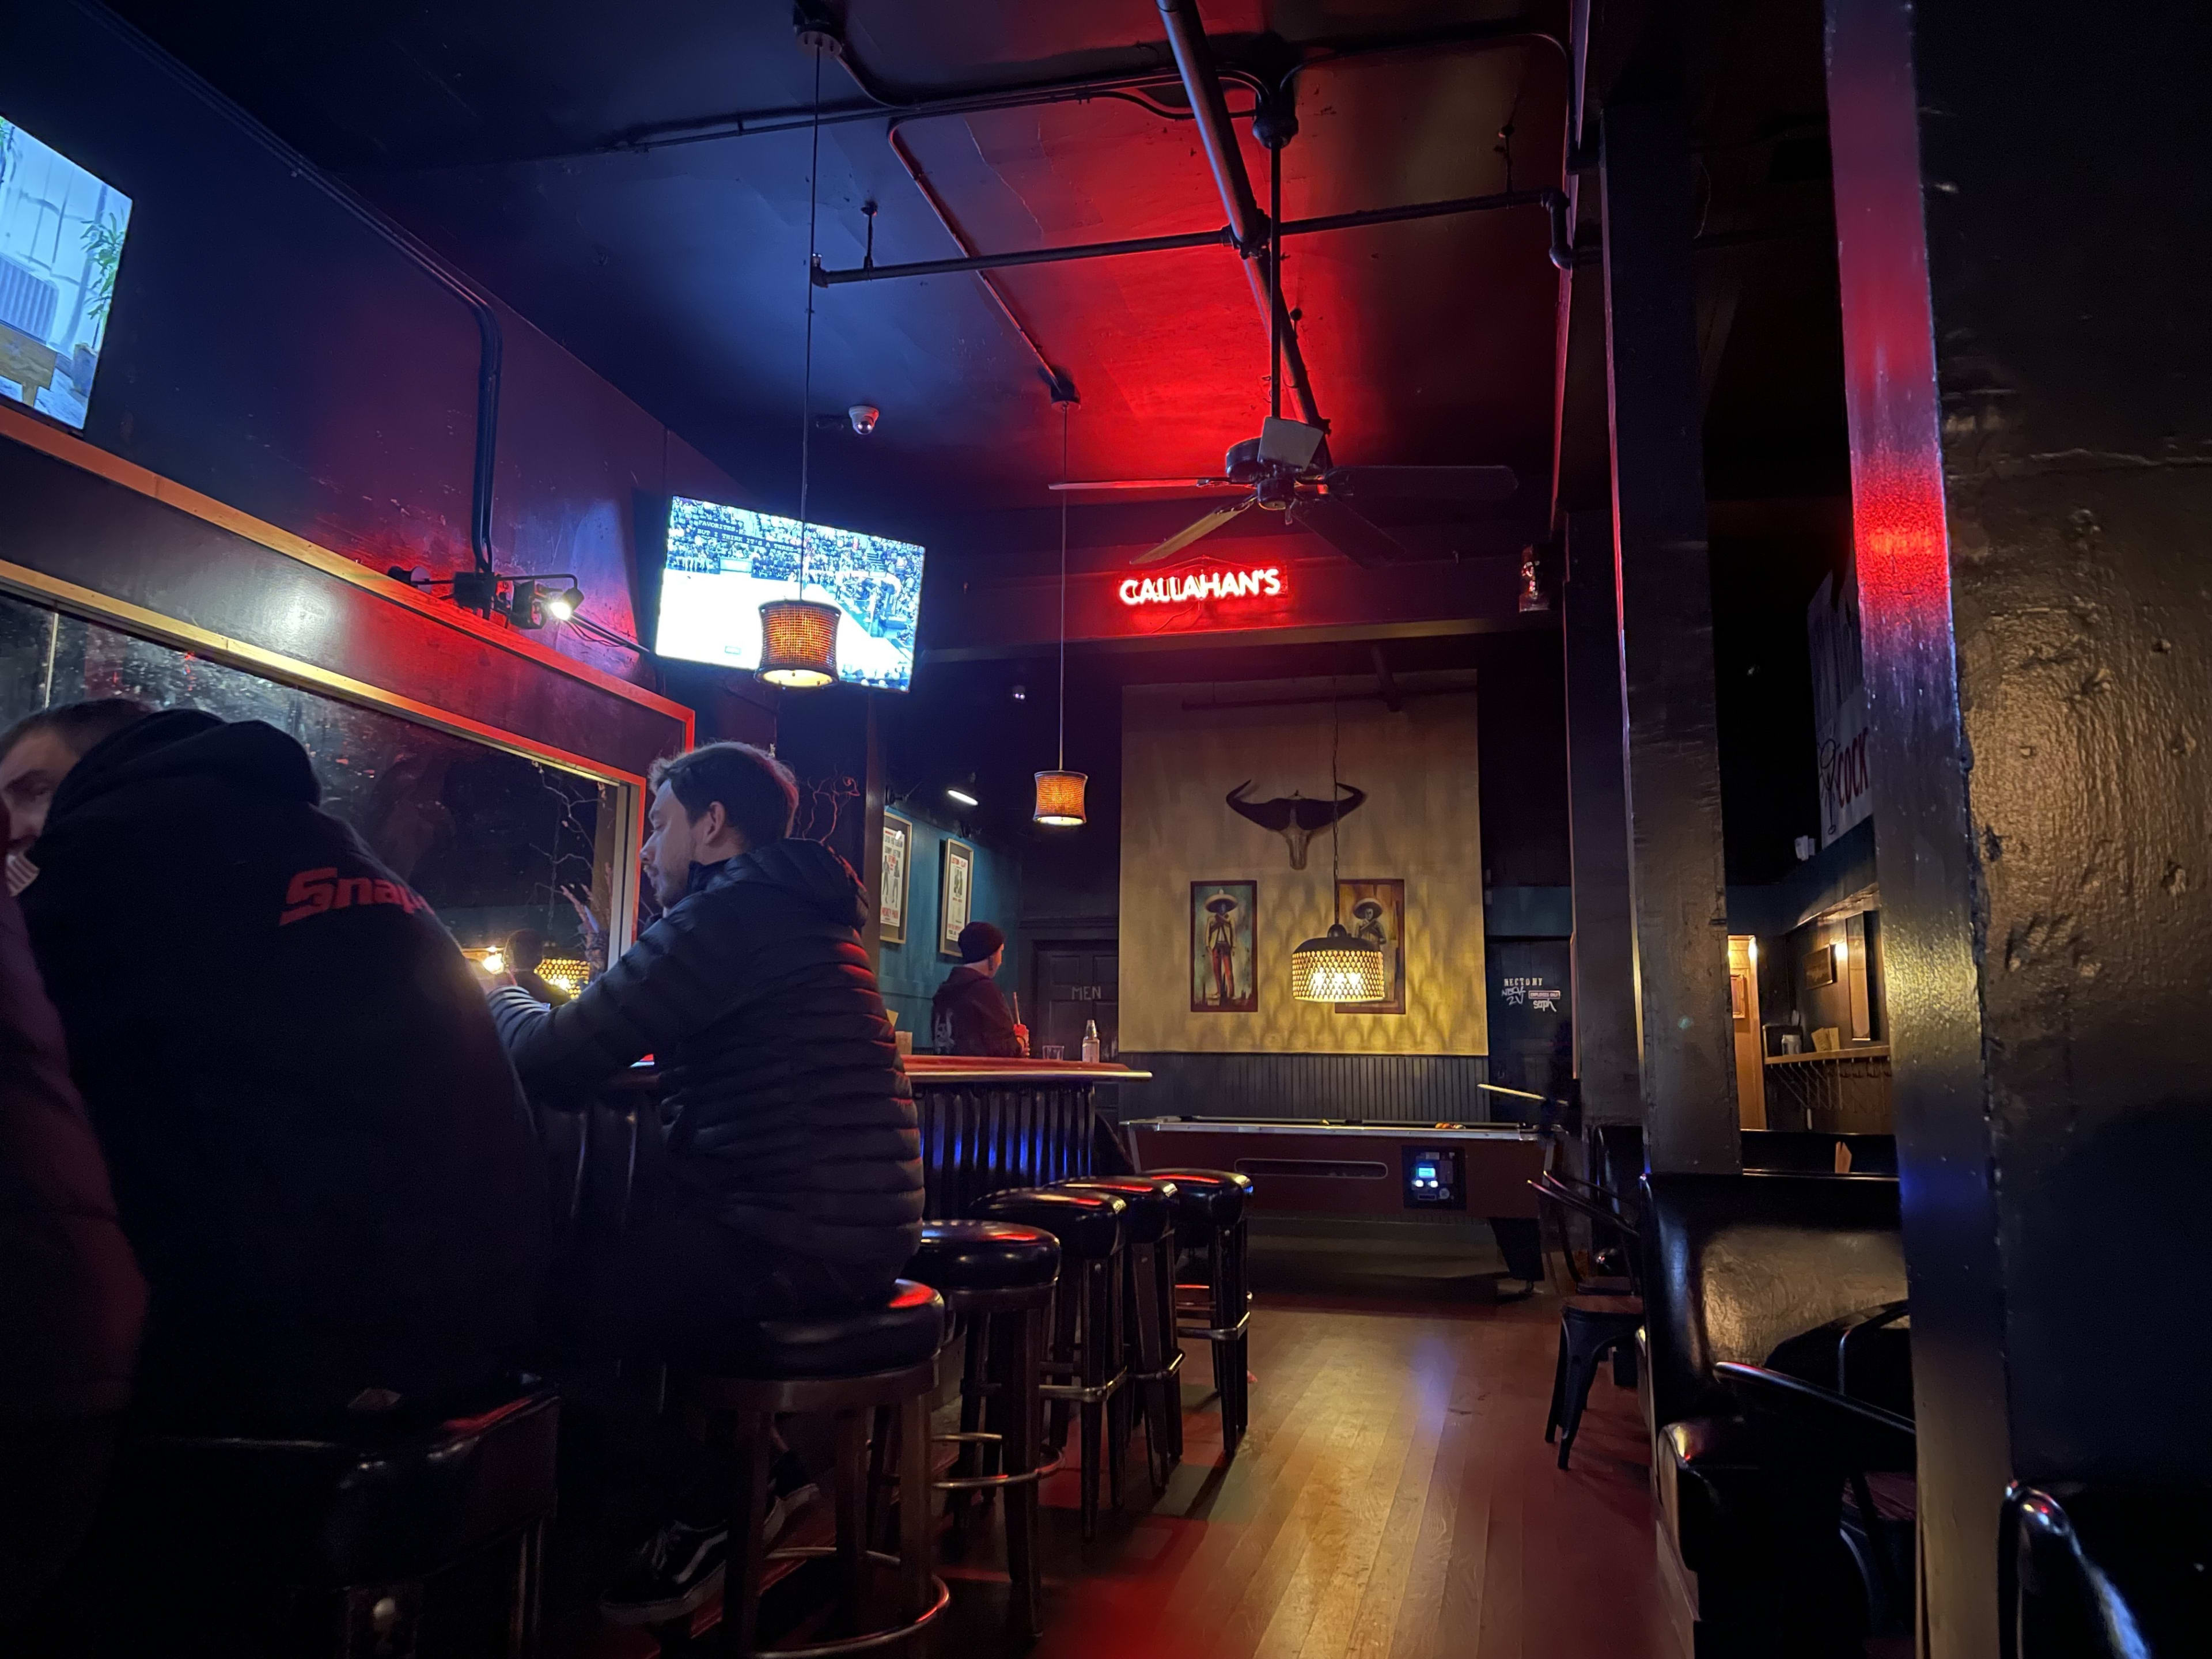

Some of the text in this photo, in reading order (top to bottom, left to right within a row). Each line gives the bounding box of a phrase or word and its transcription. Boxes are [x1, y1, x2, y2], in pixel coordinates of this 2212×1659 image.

[722, 533, 743, 542] THINK
[1119, 569, 1282, 605] CALLAHAN'S
[1071, 986, 1101, 1001] MEN
